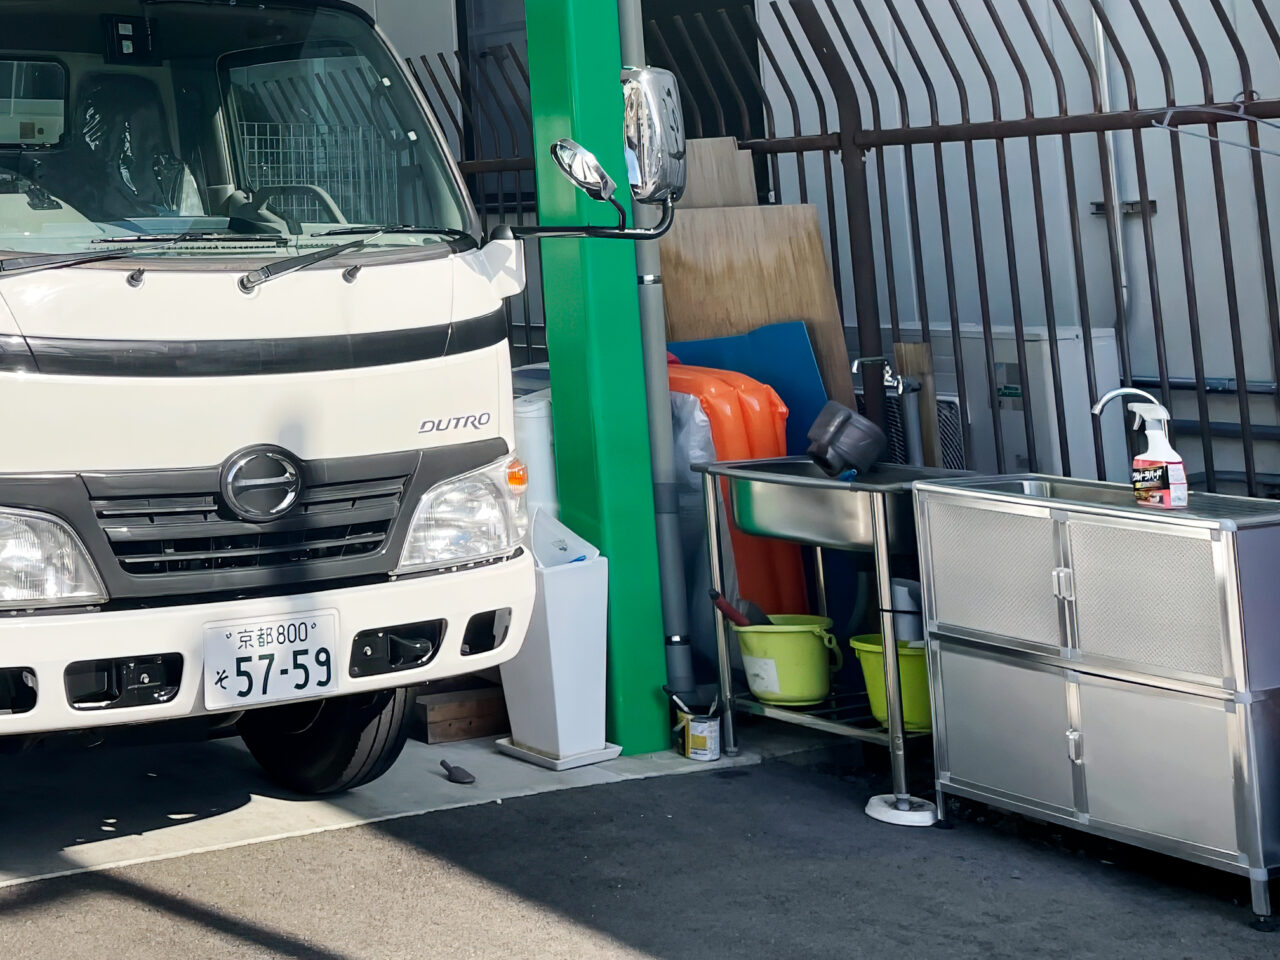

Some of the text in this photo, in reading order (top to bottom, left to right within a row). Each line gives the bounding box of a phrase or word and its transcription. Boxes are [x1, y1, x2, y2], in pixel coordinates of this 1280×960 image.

[418, 412, 490, 434] DUTRO
[214, 647, 332, 698] そ 57-59
